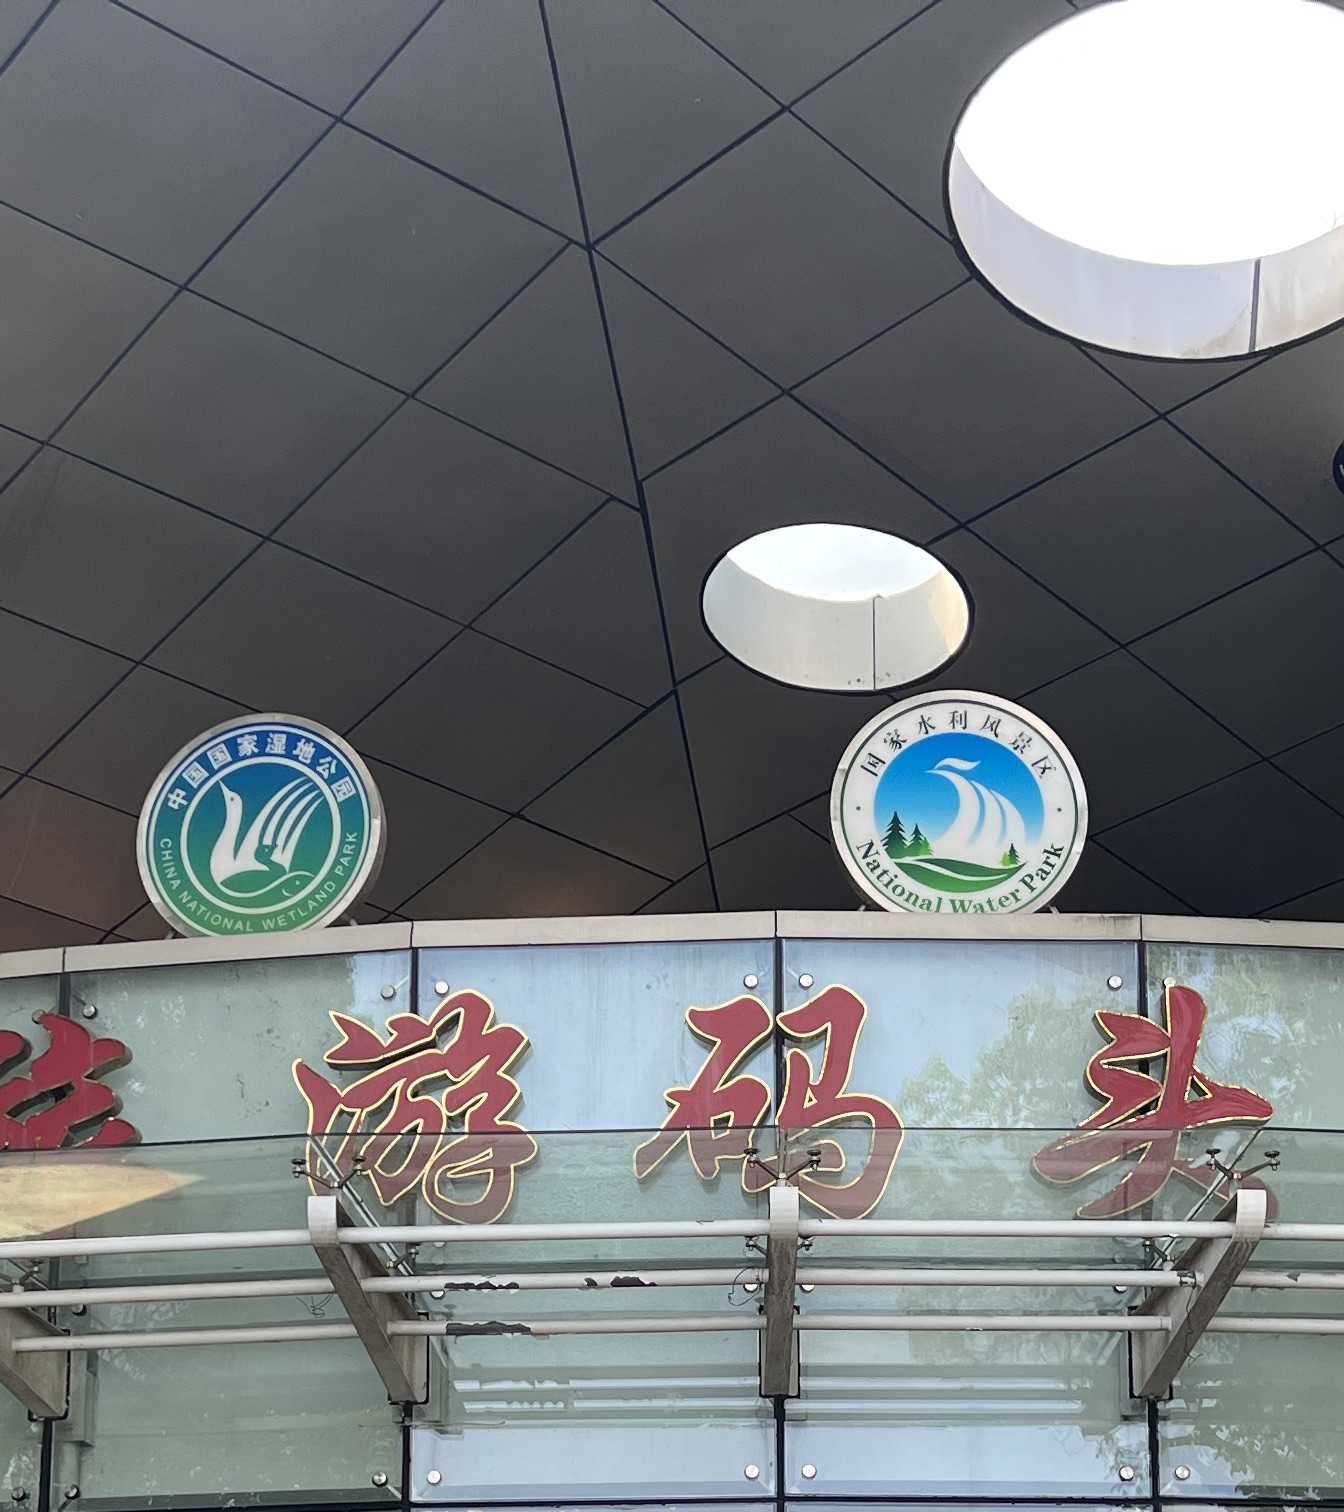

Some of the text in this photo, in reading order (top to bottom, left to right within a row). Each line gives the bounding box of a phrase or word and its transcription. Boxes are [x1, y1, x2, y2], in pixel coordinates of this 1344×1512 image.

[167, 732, 356, 811] 中国国家湿地公园
[860, 709, 1056, 778] 国家水利风景区
[159, 831, 359, 932] CHINA NATIONAL WETLAND PARK
[856, 839, 1066, 913] National Water Park
